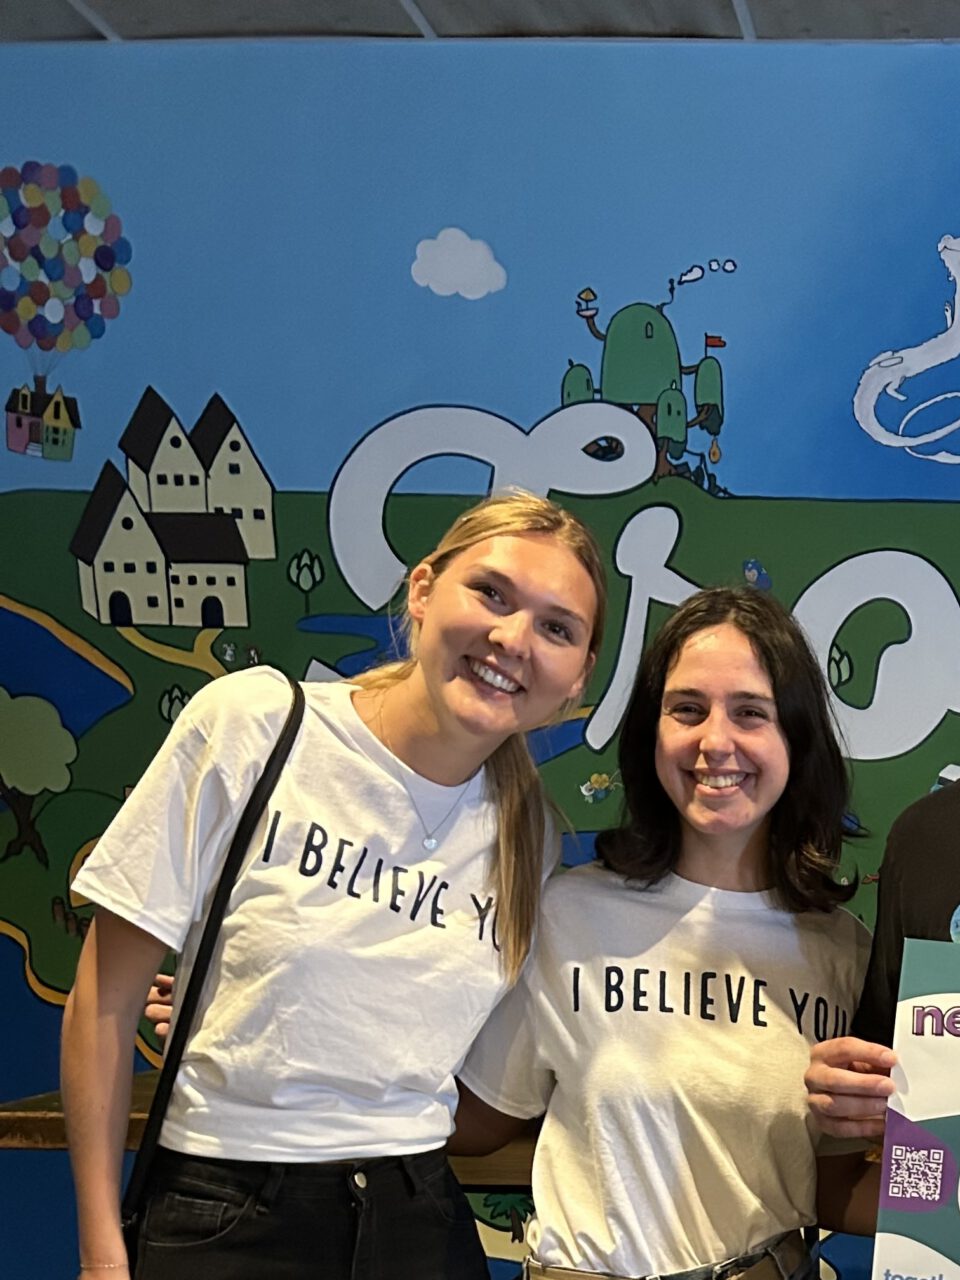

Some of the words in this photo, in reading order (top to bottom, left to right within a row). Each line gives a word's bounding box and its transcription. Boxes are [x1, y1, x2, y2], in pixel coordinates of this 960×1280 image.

[262, 810, 282, 863] I
[299, 821, 449, 929] BELIEVE
[573, 966, 581, 1012] I
[604, 965, 768, 1028] BELIEVE
